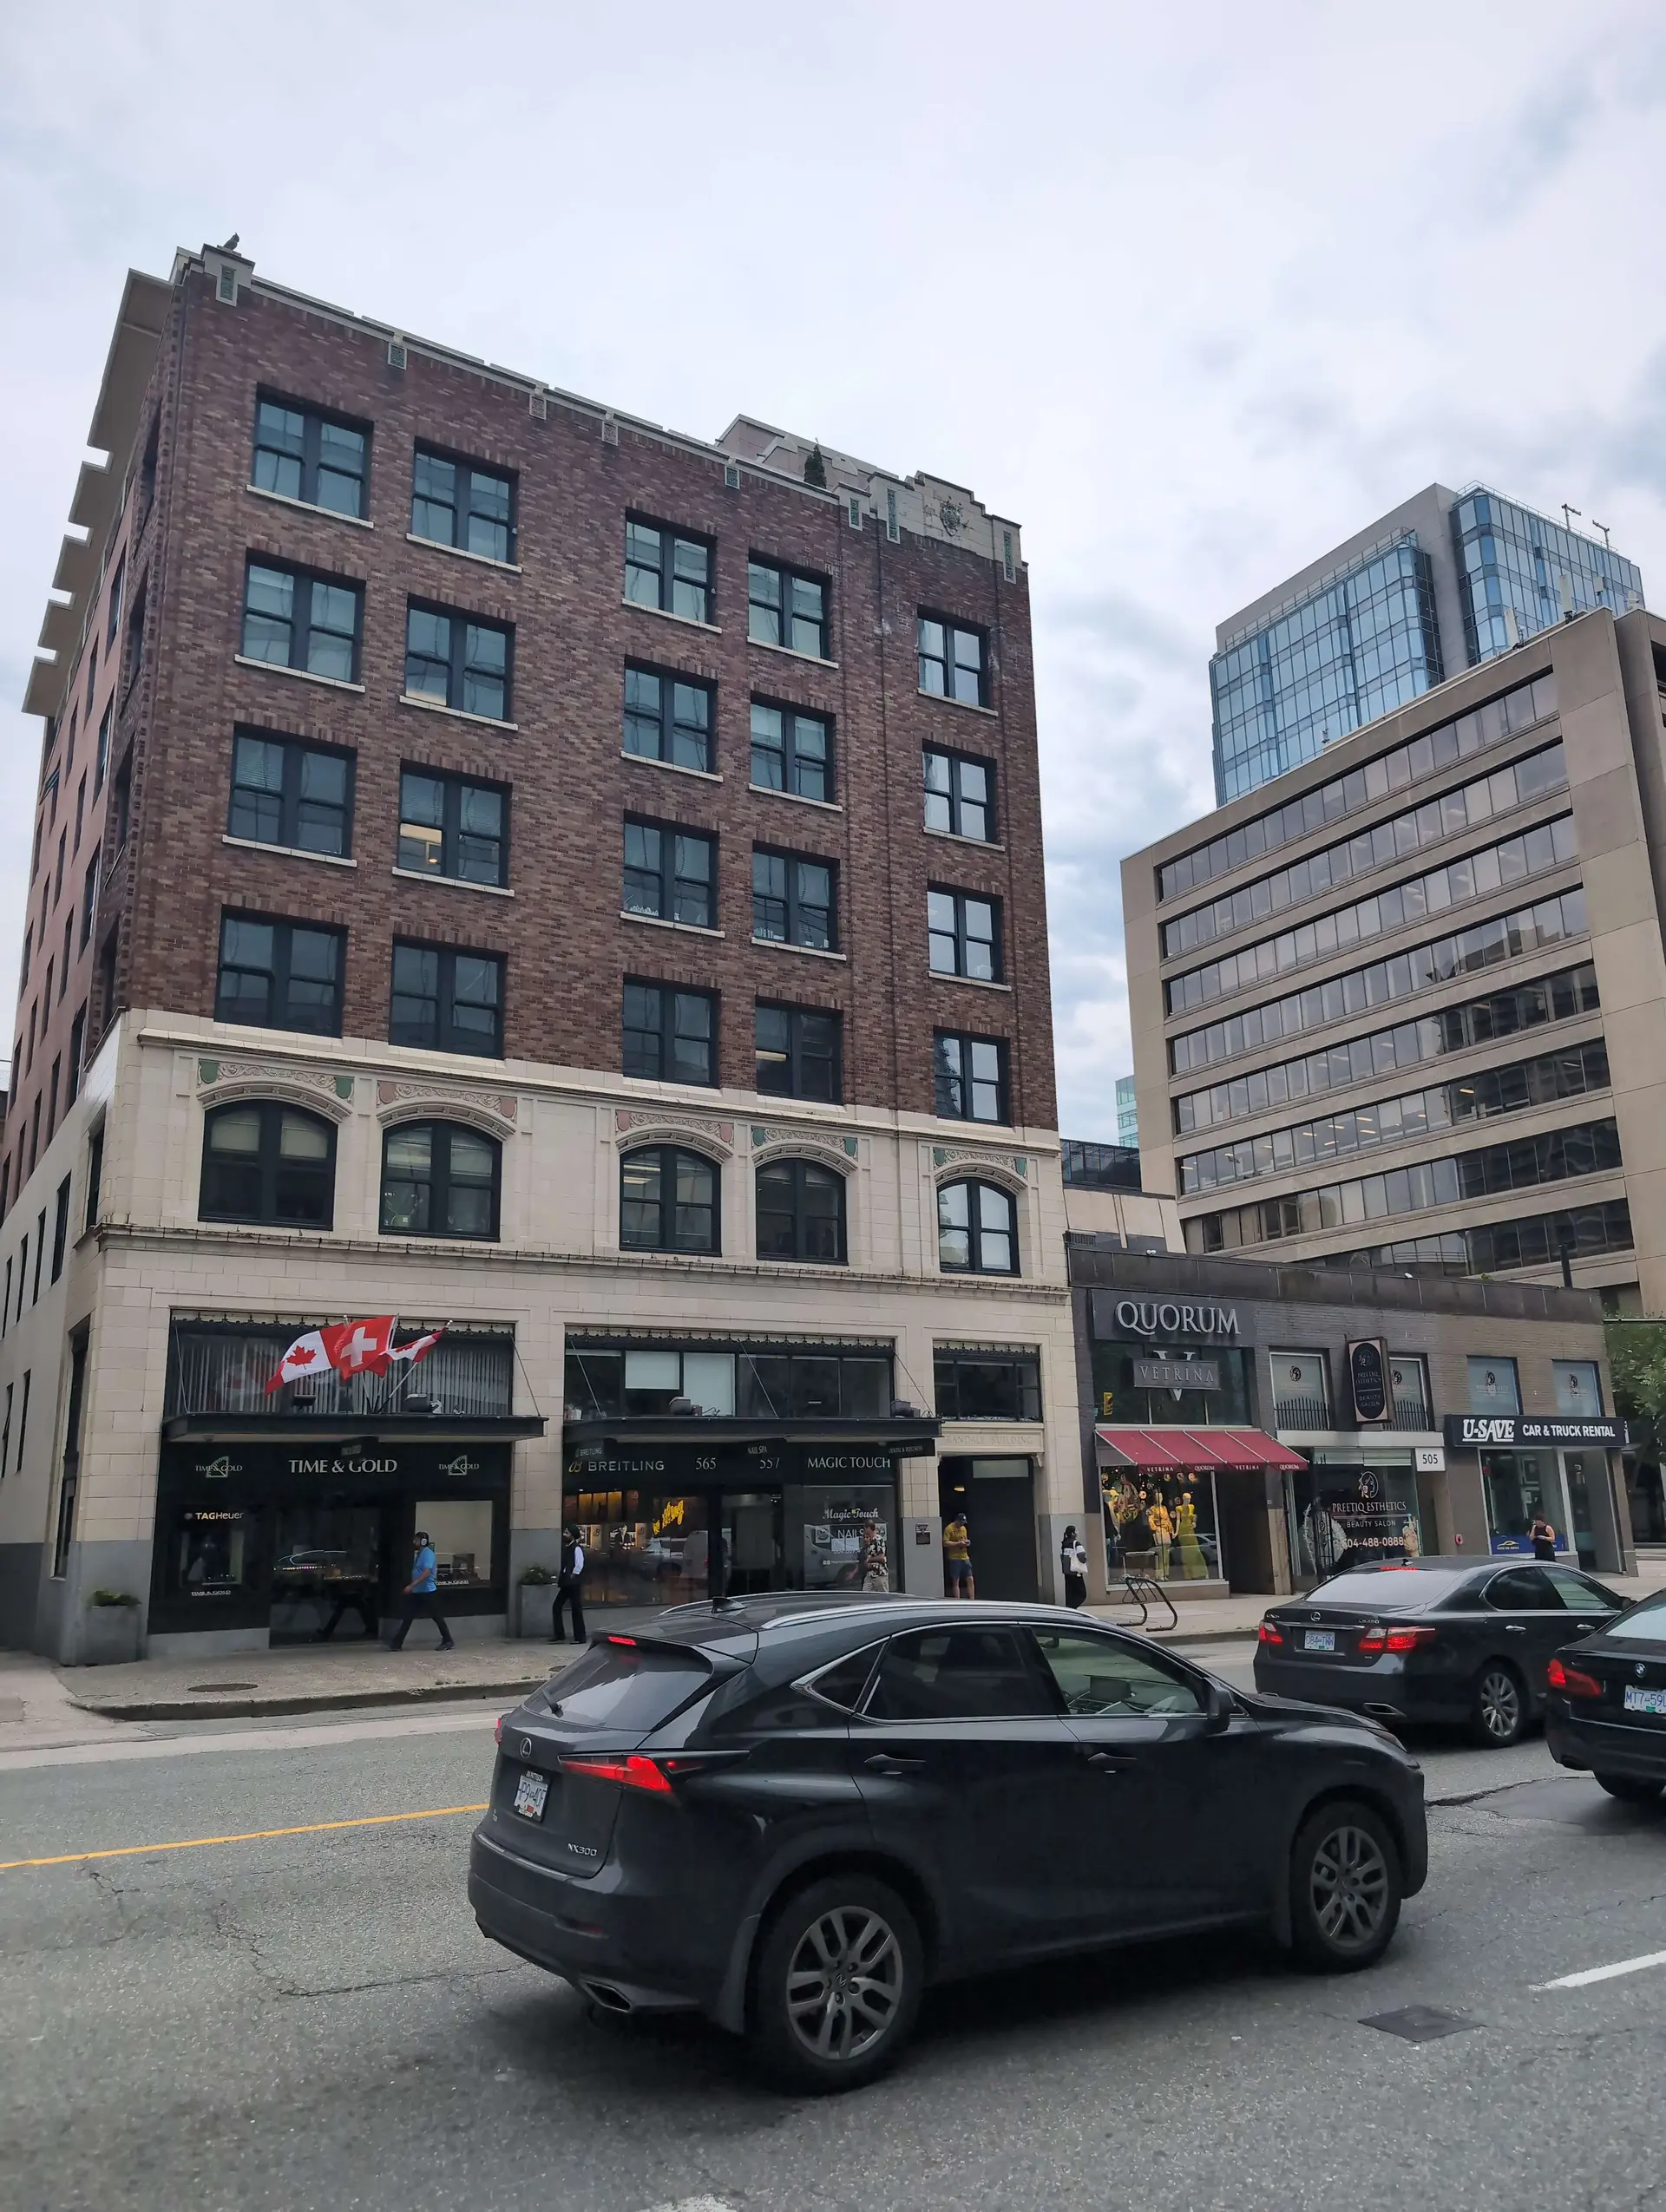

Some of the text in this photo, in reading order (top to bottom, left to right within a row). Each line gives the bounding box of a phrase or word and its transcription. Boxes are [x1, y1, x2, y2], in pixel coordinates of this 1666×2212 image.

[1116, 1301, 1242, 1336] QUORUM
[1139, 1365, 1215, 1383] VETRINA
[1462, 1419, 1515, 1442] U-SAVE
[1522, 1424, 1542, 1436] CAR
[1543, 1424, 1551, 1436] &
[1551, 1425, 1581, 1436] TRUCK
[1583, 1425, 1616, 1437] RENTAL
[991, 1436, 1033, 1444] BUILDING
[580, 1447, 602, 1456] BREITLING
[696, 1457, 717, 1469] 565
[807, 1456, 891, 1468] MAGIC TOUCH
[1422, 1454, 1439, 1464] 505
[288, 1459, 398, 1473] TIME & GOLD
[587, 1460, 665, 1472] BREITLING
[1332, 1501, 1407, 1514] PREETIQ ESTHETICS
[823, 1508, 879, 1522] Magic Touch
[567, 1842, 598, 1856] NX300
